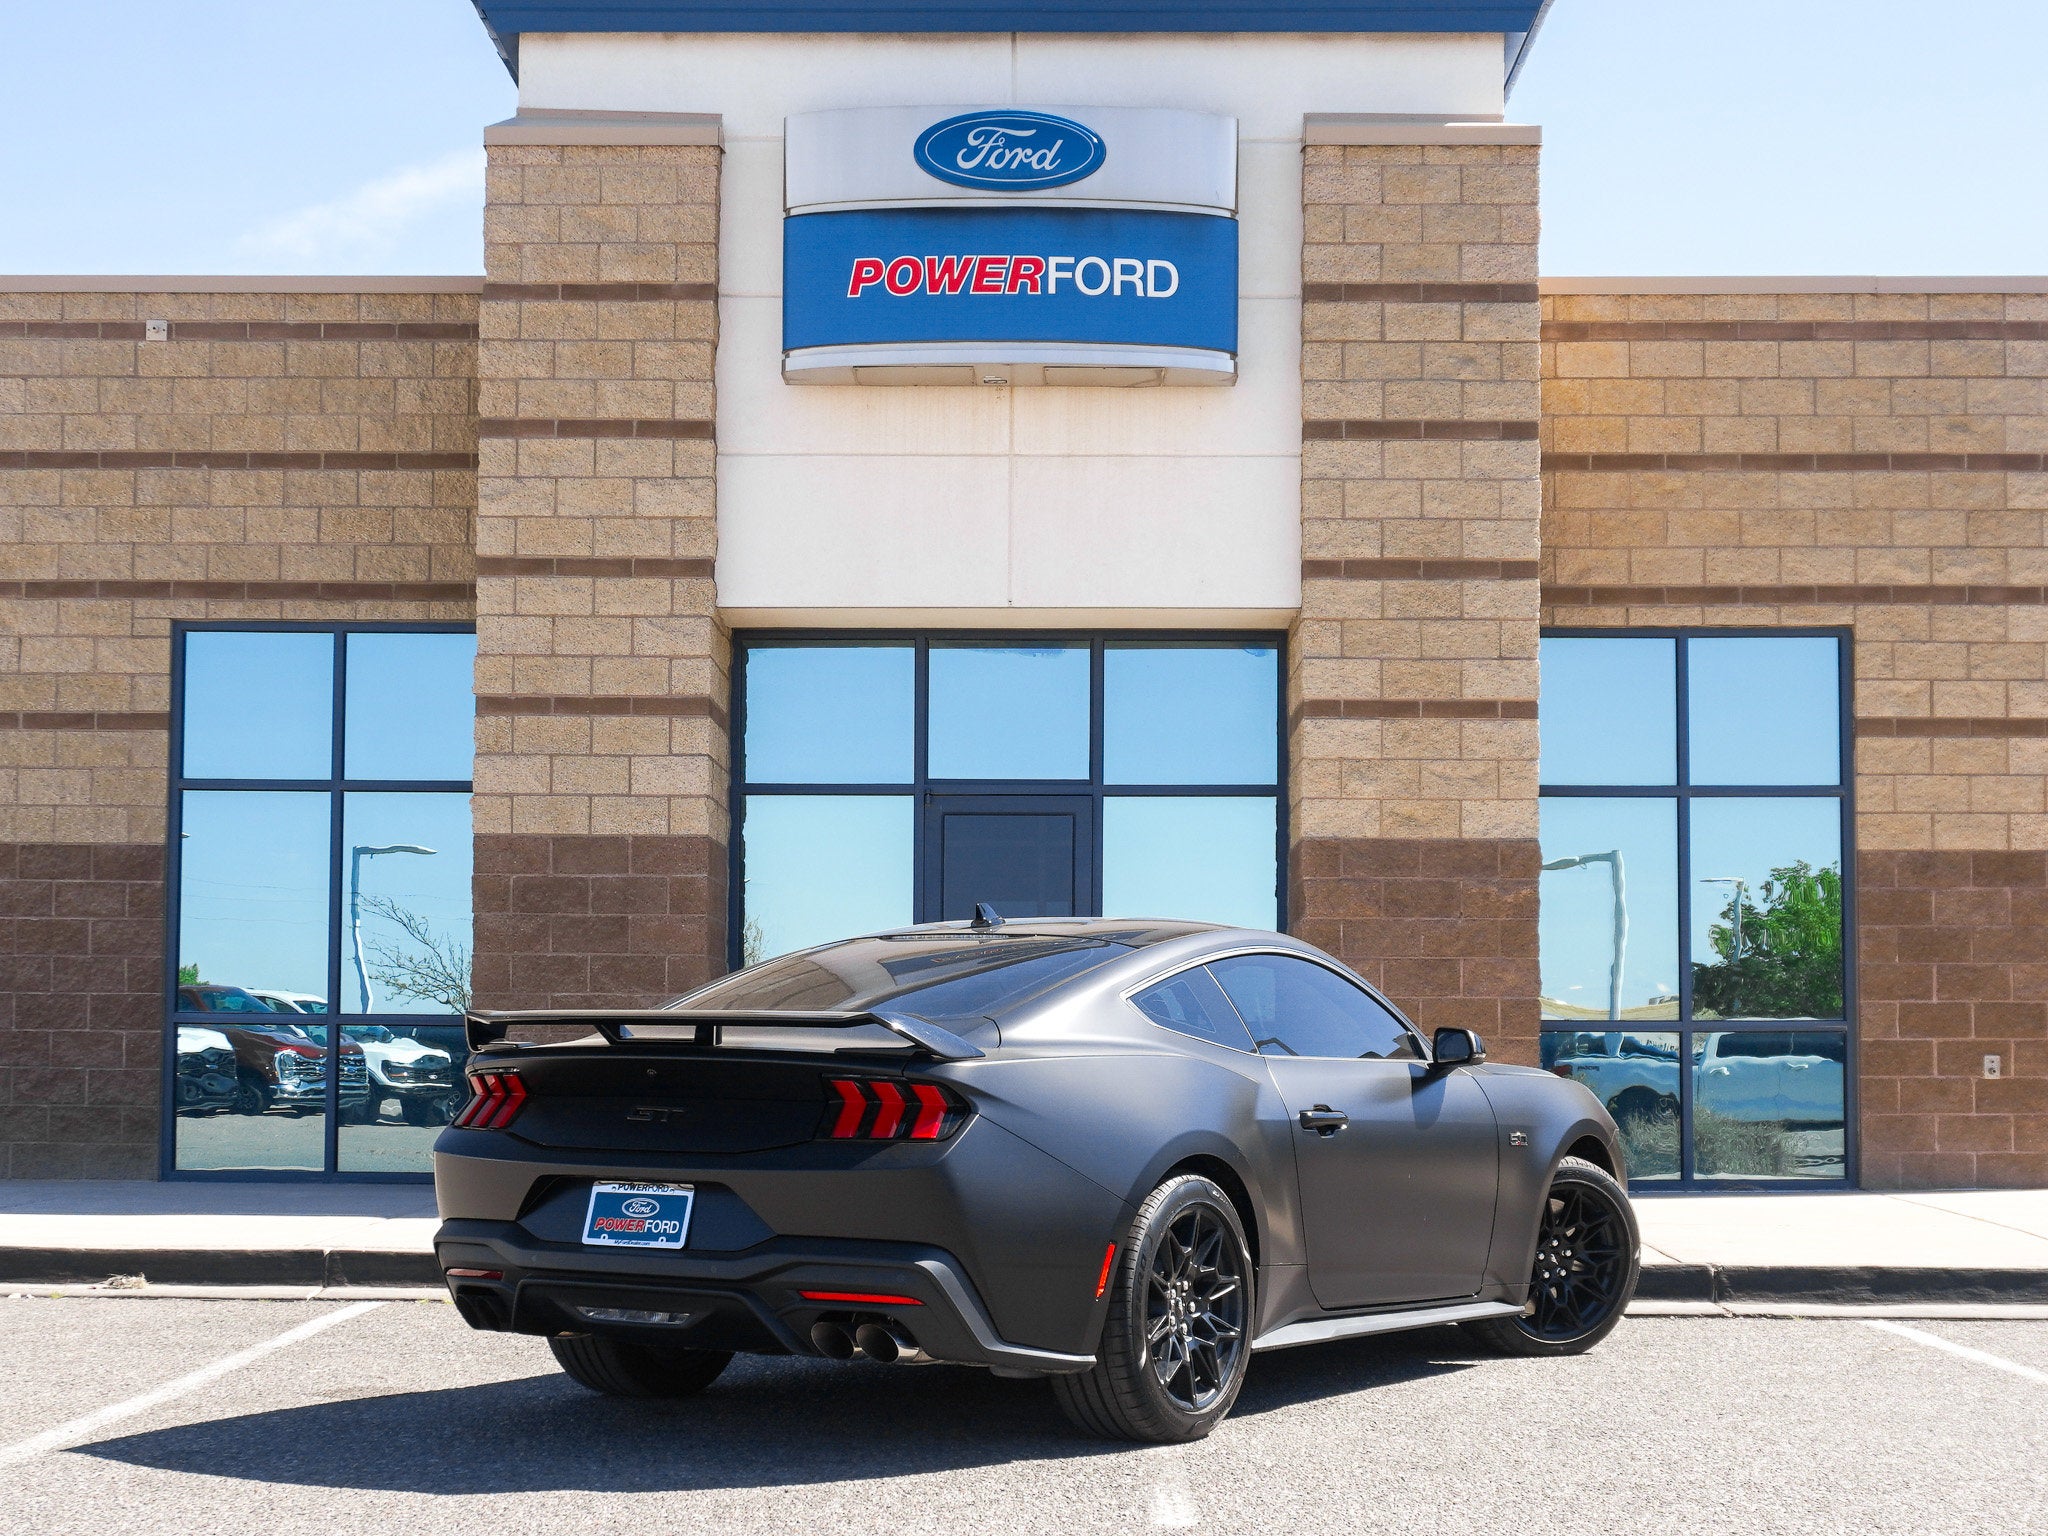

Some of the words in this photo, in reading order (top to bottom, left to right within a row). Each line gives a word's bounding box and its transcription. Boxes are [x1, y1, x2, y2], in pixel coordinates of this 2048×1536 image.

[956, 126, 1063, 171] Ford
[847, 255, 1179, 298] POWERFORD
[617, 1183, 669, 1192] POWERFORD
[628, 1201, 653, 1214] Ford
[594, 1217, 680, 1234] POWERFORD
